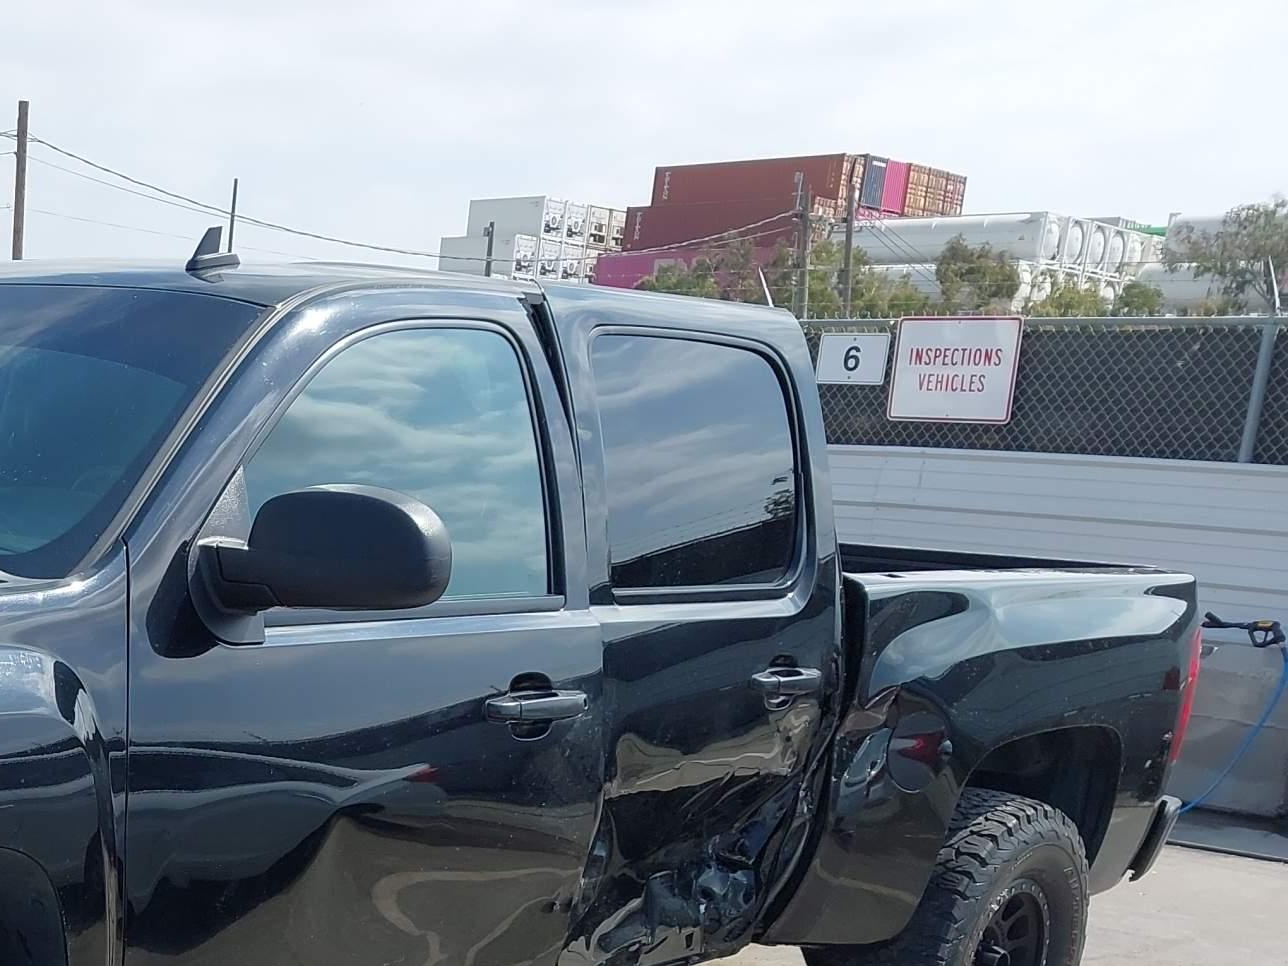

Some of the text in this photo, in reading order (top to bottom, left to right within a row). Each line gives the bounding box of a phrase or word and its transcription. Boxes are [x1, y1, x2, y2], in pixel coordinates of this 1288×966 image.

[843, 345, 861, 372] 6
[908, 347, 1003, 367] INSPECTIONS
[918, 373, 987, 393] VEHICLES
